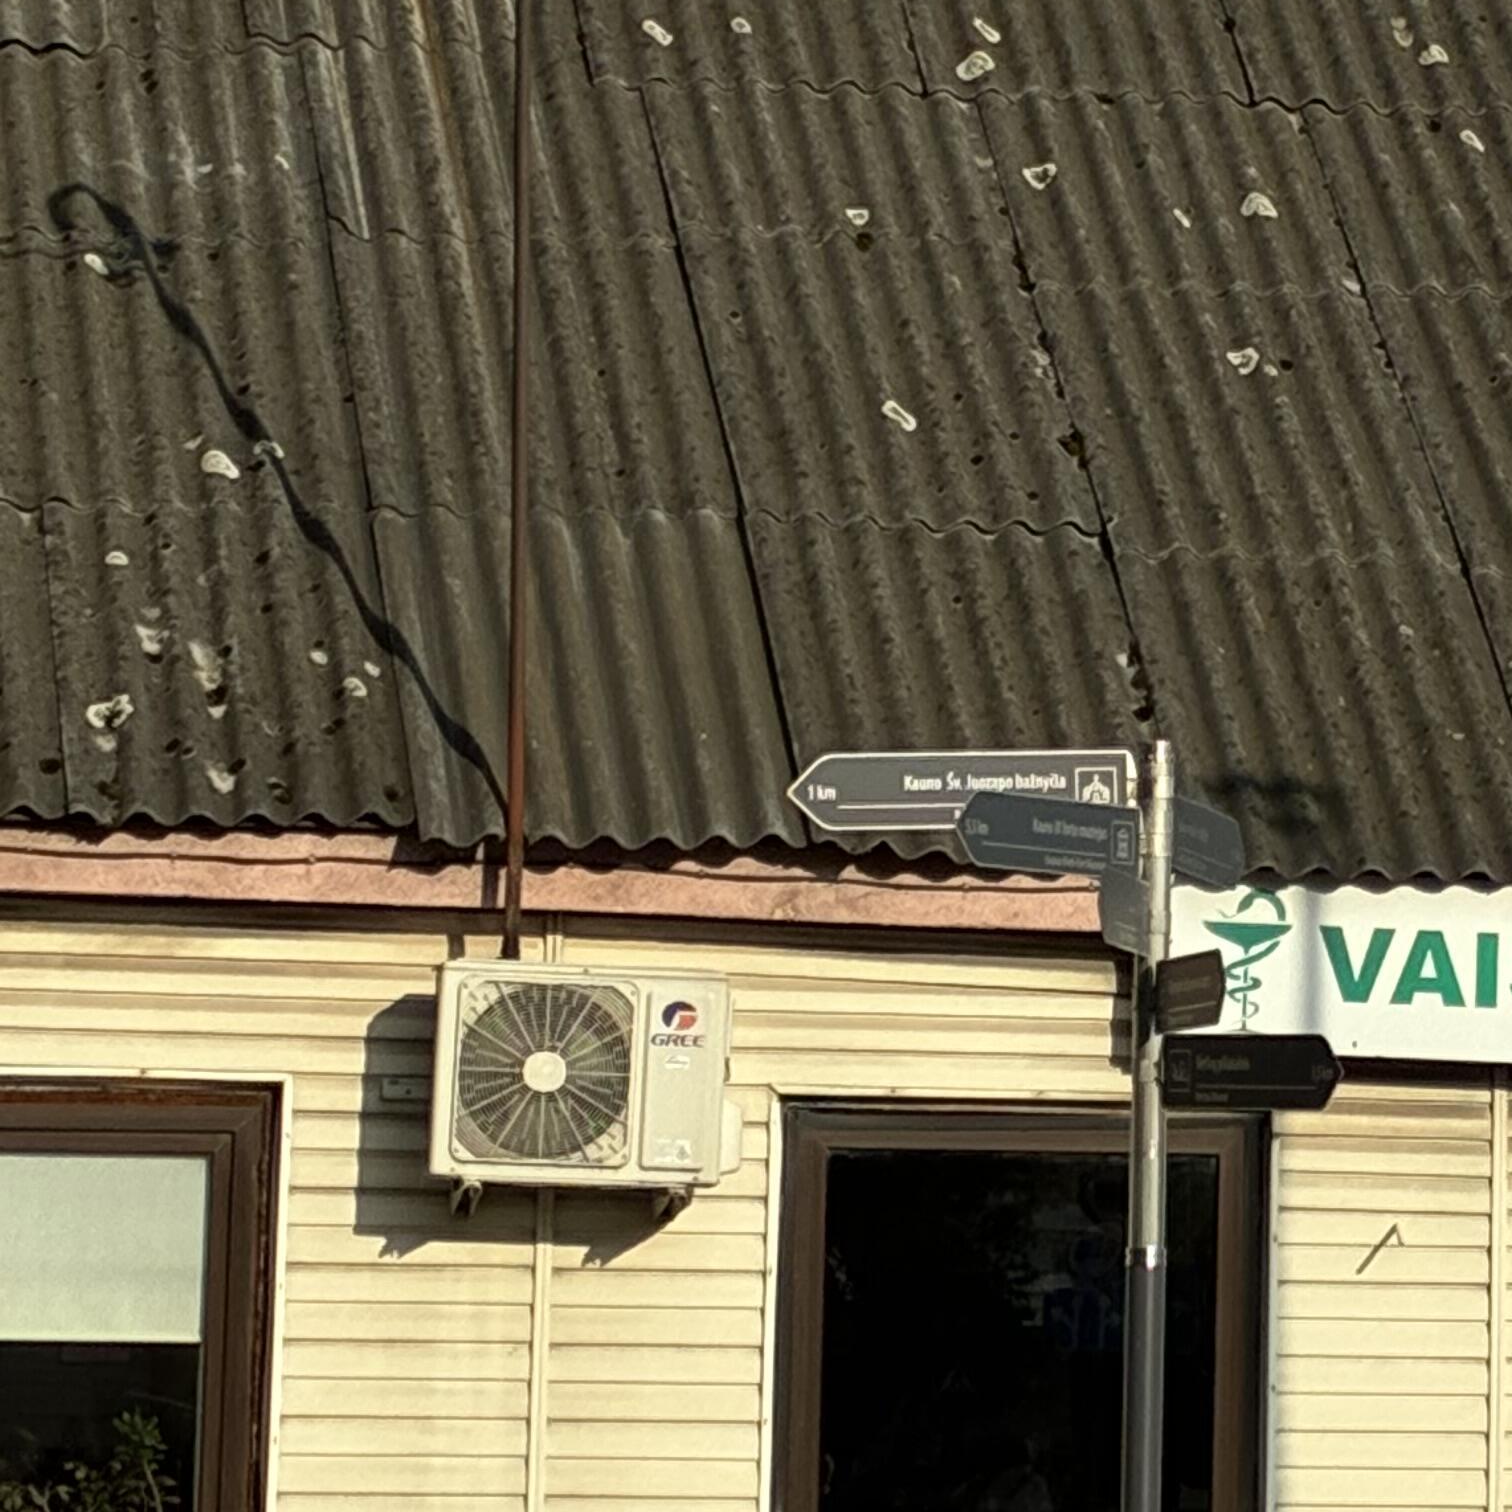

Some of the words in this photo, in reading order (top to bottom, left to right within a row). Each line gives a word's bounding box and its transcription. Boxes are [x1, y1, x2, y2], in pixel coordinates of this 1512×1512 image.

[903, 774, 943, 792] Kauno
[965, 772, 1013, 793] Juozapo
[808, 784, 814, 801] 1
[817, 784, 837, 801] km
[650, 1033, 705, 1048] GREE
